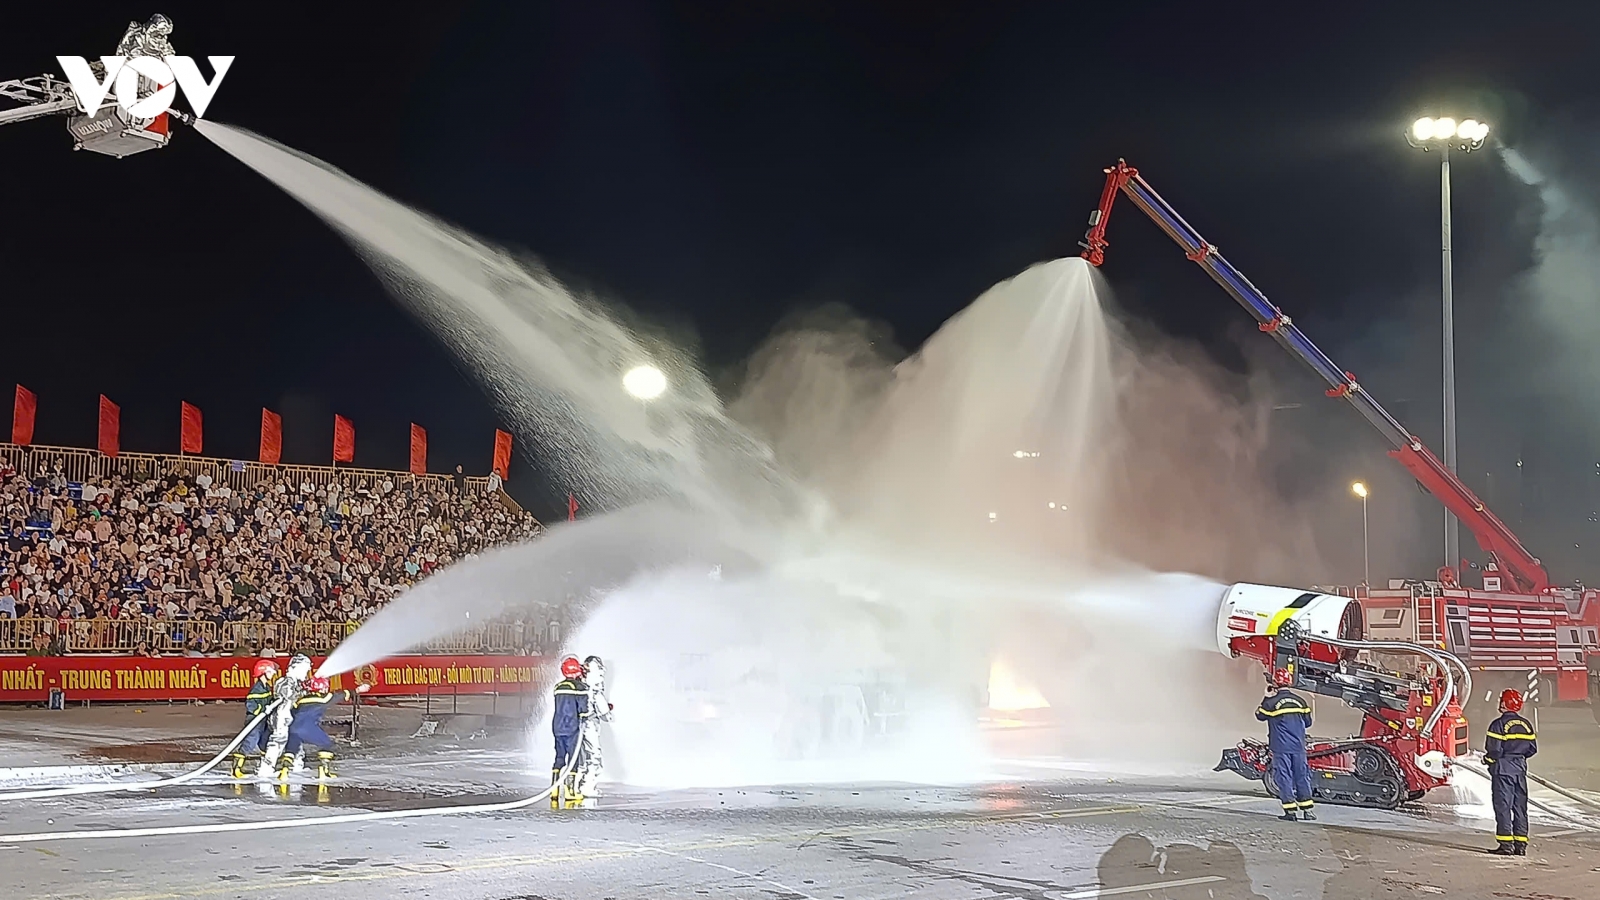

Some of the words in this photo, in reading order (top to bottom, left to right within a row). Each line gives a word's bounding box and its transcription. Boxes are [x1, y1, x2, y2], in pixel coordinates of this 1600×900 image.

[77, 118, 114, 136] MORITA
[2, 662, 45, 690] NHẤT
[60, 669, 111, 690] TRUNG
[115, 662, 165, 689] THÀNH
[169, 663, 207, 689] NHẤT
[220, 663, 250, 688] GẦN
[384, 667, 401, 685] THEO
[518, 667, 531, 683] CAO
